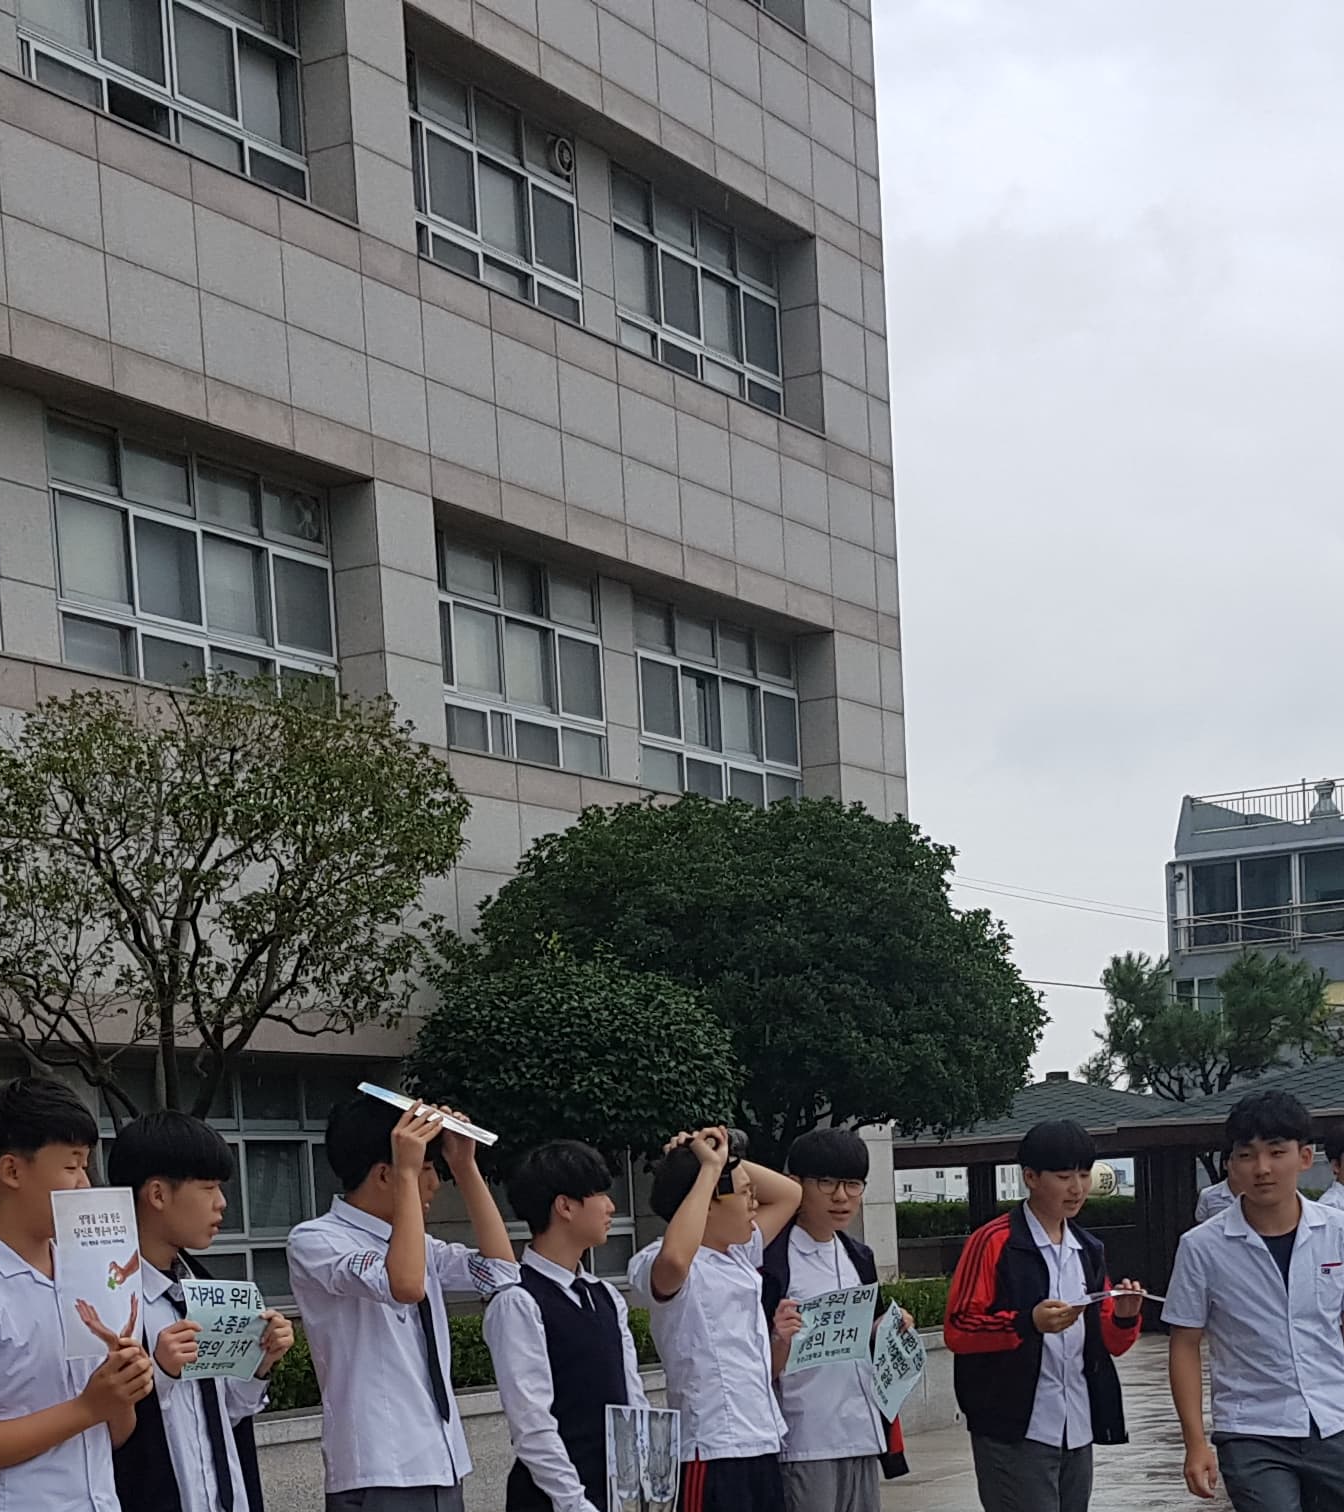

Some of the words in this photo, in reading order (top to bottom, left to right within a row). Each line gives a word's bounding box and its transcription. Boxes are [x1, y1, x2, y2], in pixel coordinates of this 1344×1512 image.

[187, 1286, 226, 1307] 지켜요
[229, 1287, 251, 1310] 우리
[825, 1291, 849, 1308] 우리
[852, 1288, 875, 1304] 같이
[211, 1316, 250, 1335] 소중한
[832, 1328, 858, 1345] 가치
[196, 1340, 224, 1357] 명의
[225, 1339, 253, 1357] 가치
